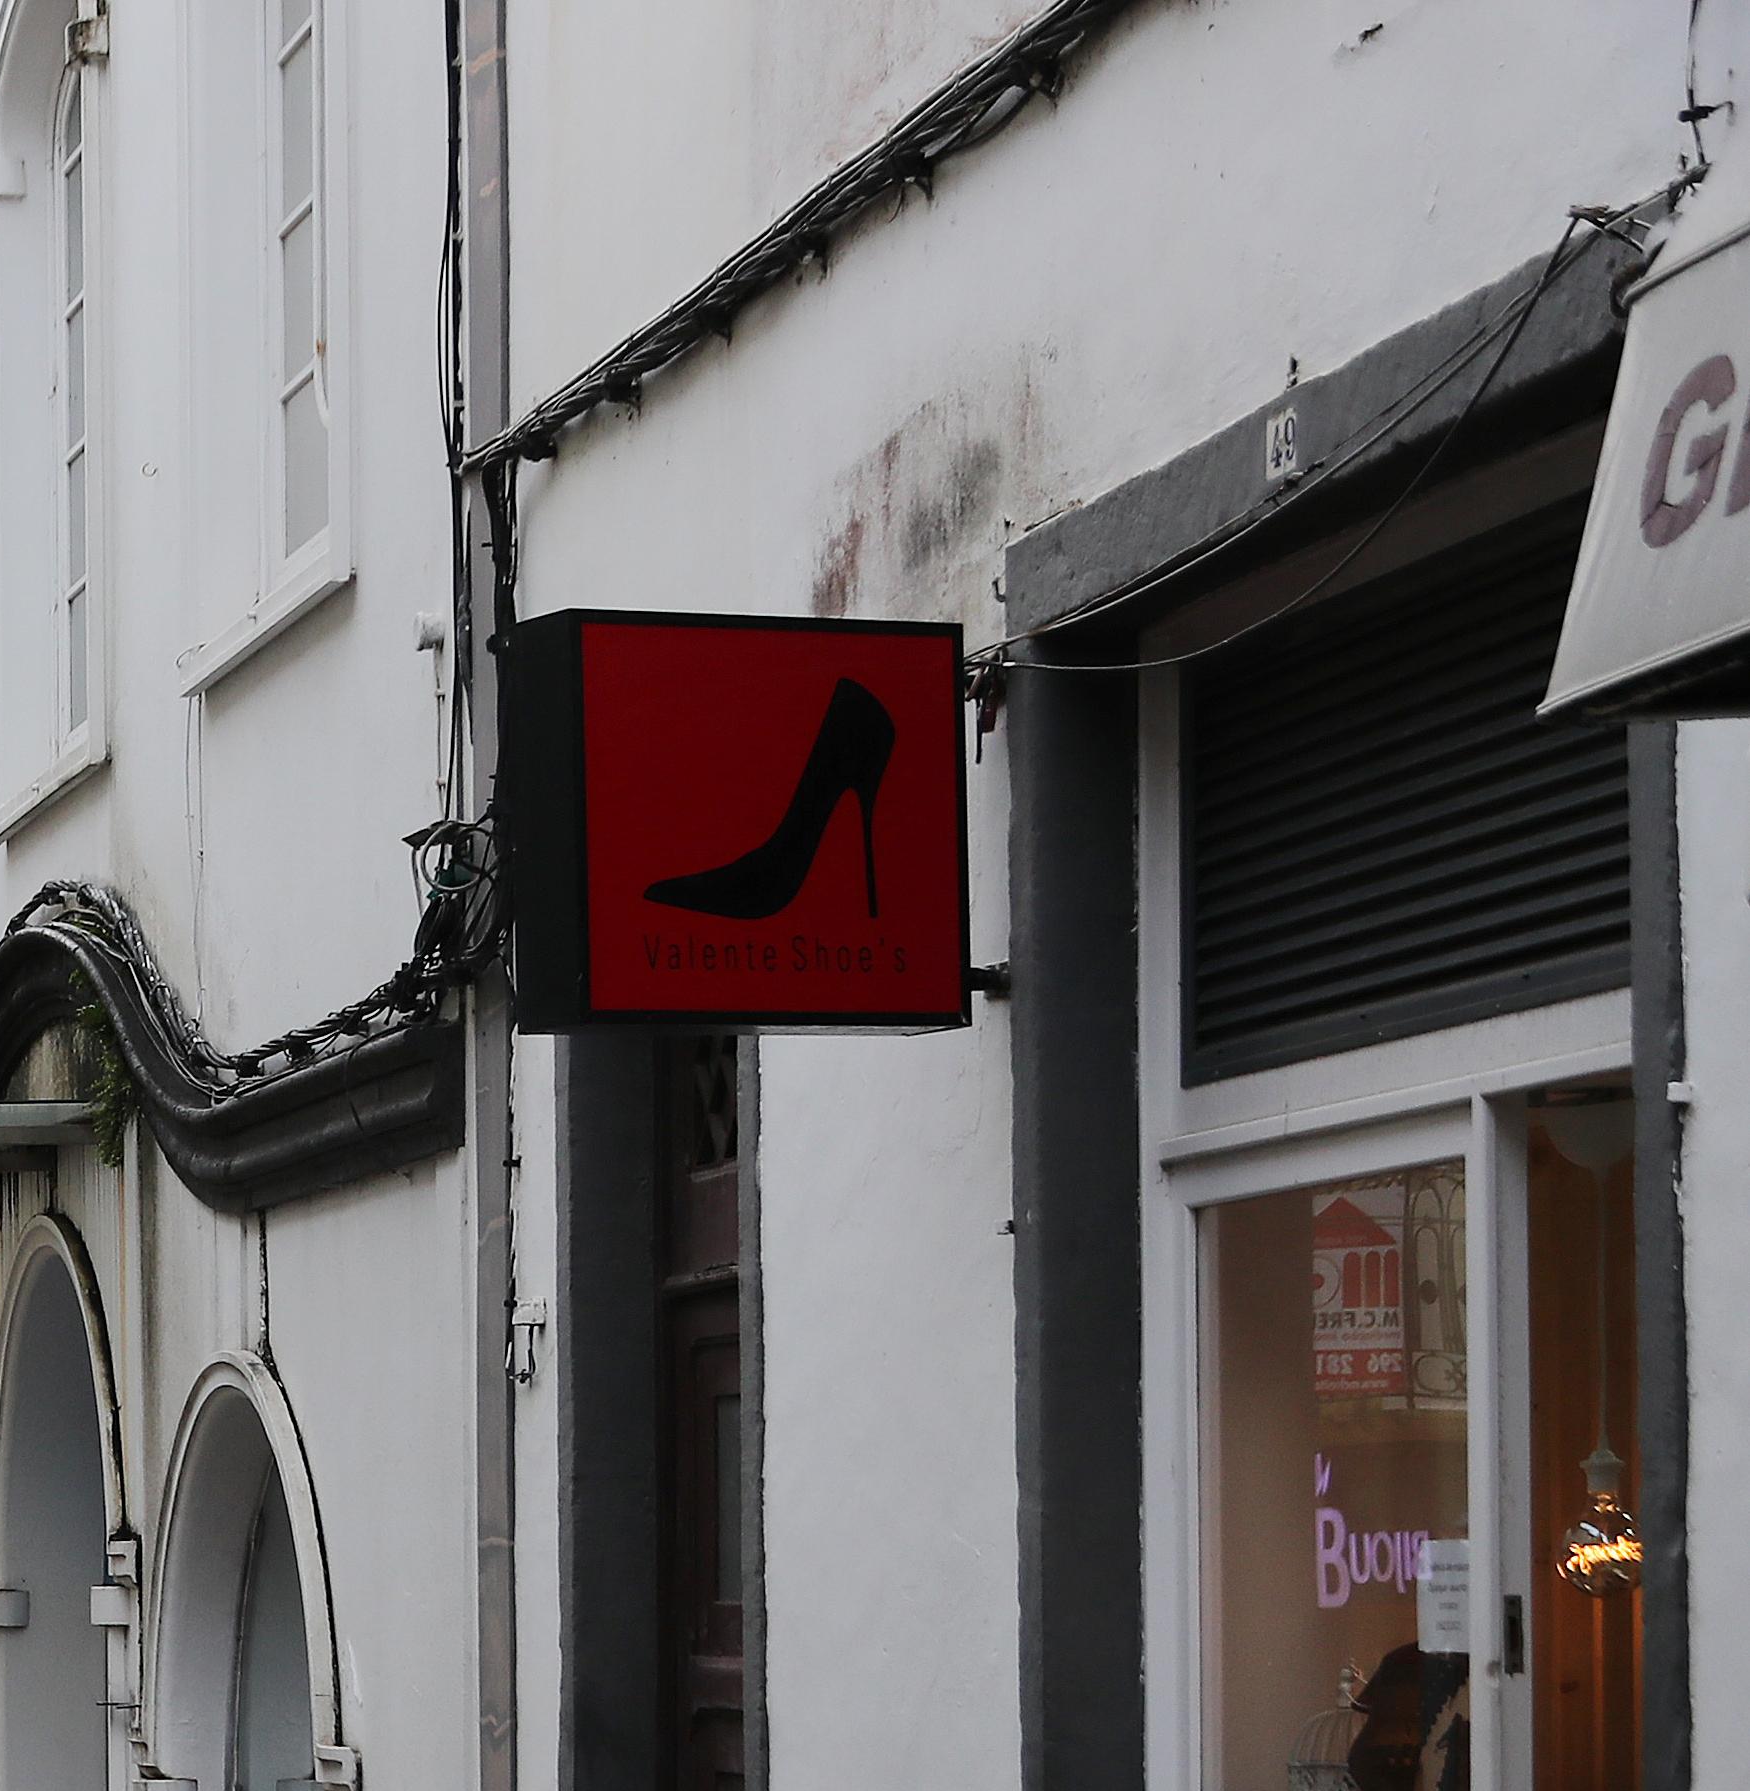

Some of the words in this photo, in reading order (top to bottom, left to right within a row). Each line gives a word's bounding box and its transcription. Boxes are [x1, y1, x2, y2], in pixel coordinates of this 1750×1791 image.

[1269, 415, 1297, 469] 49
[643, 934, 778, 973] Valente
[790, 934, 909, 974] Shoe's
